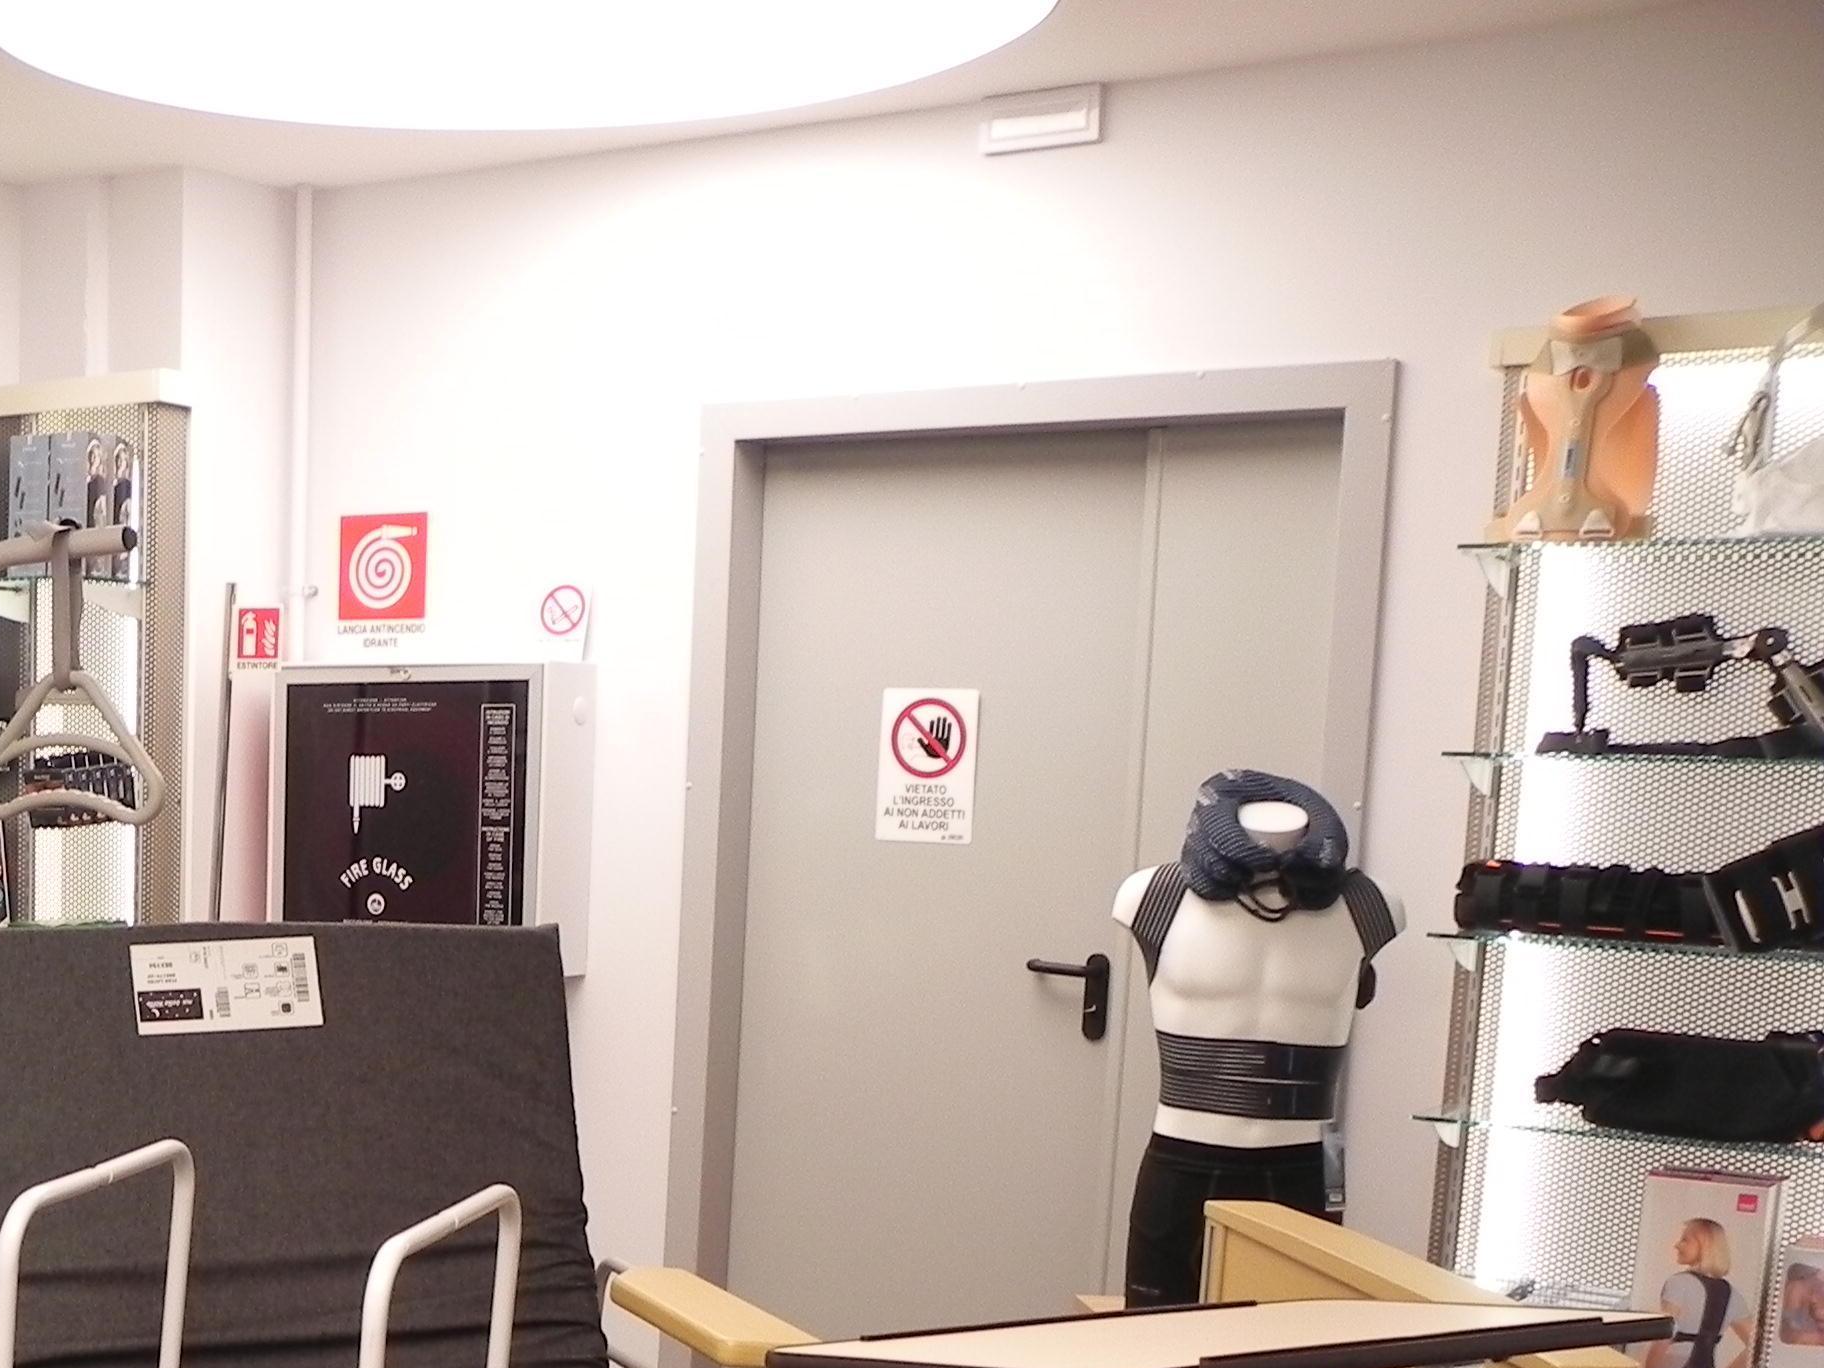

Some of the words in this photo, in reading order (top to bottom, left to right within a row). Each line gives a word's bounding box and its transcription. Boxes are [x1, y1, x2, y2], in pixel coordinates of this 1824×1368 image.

[337, 624, 368, 635] LANCIA
[370, 623, 426, 634] ANTINCENDIO
[363, 637, 398, 648] IDRANTE
[237, 661, 277, 670] ESTINTORE
[905, 784, 947, 795] VIETATO
[892, 795, 955, 808] L'INGRESSO
[884, 806, 894, 817] AI
[896, 807, 919, 819] NON
[921, 808, 966, 820] ADDETTI
[898, 819, 909, 830] AI
[911, 821, 949, 832] LAVORI
[340, 858, 369, 889] FIRE
[372, 856, 414, 891] GLASS
